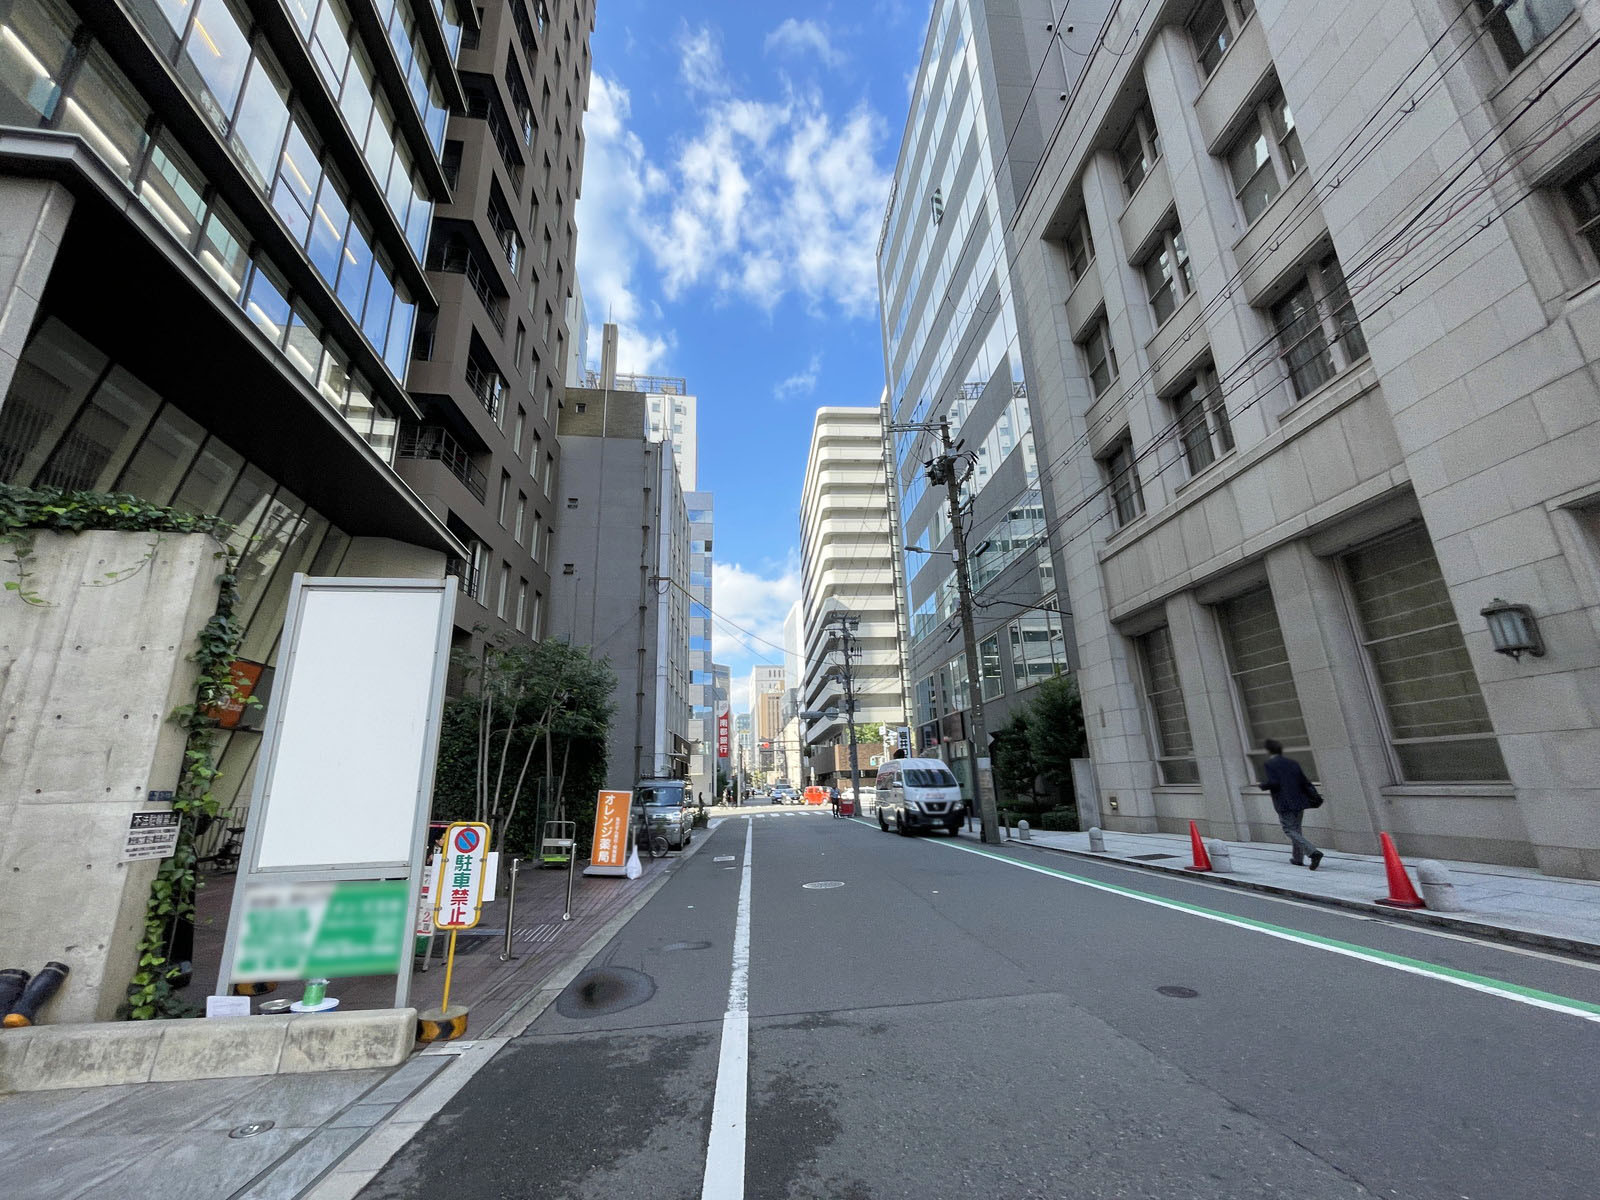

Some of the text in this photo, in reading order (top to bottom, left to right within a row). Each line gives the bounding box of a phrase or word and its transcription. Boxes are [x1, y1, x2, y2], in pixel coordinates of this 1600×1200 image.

[598, 794, 616, 863] オレンジ薬局
[448, 854, 473, 925] 駐車禁止
